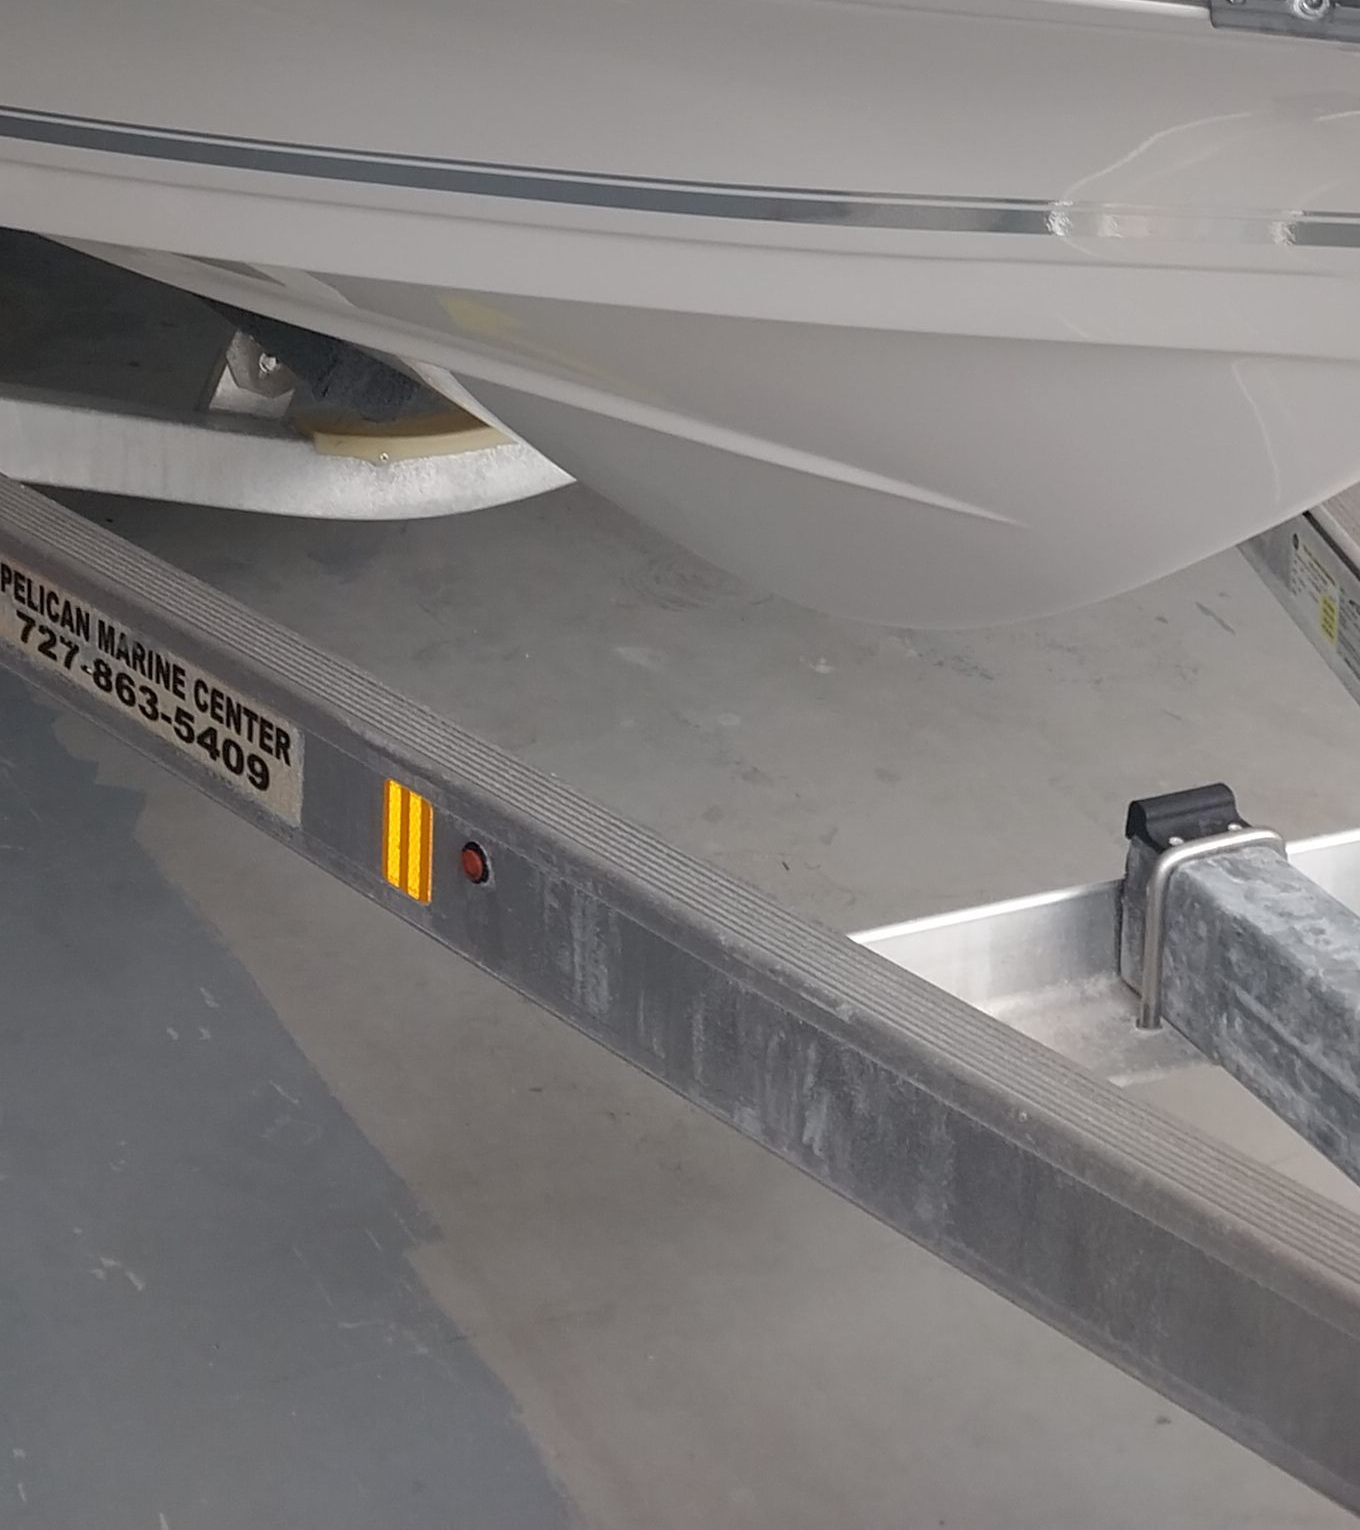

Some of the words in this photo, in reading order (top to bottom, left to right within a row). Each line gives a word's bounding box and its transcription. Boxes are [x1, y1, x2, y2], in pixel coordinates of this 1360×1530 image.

[0, 562, 90, 643] PELICAN
[97, 619, 186, 701] MARINE
[193, 677, 292, 767] CENTER
[16, 609, 271, 792] 727-863-5409
